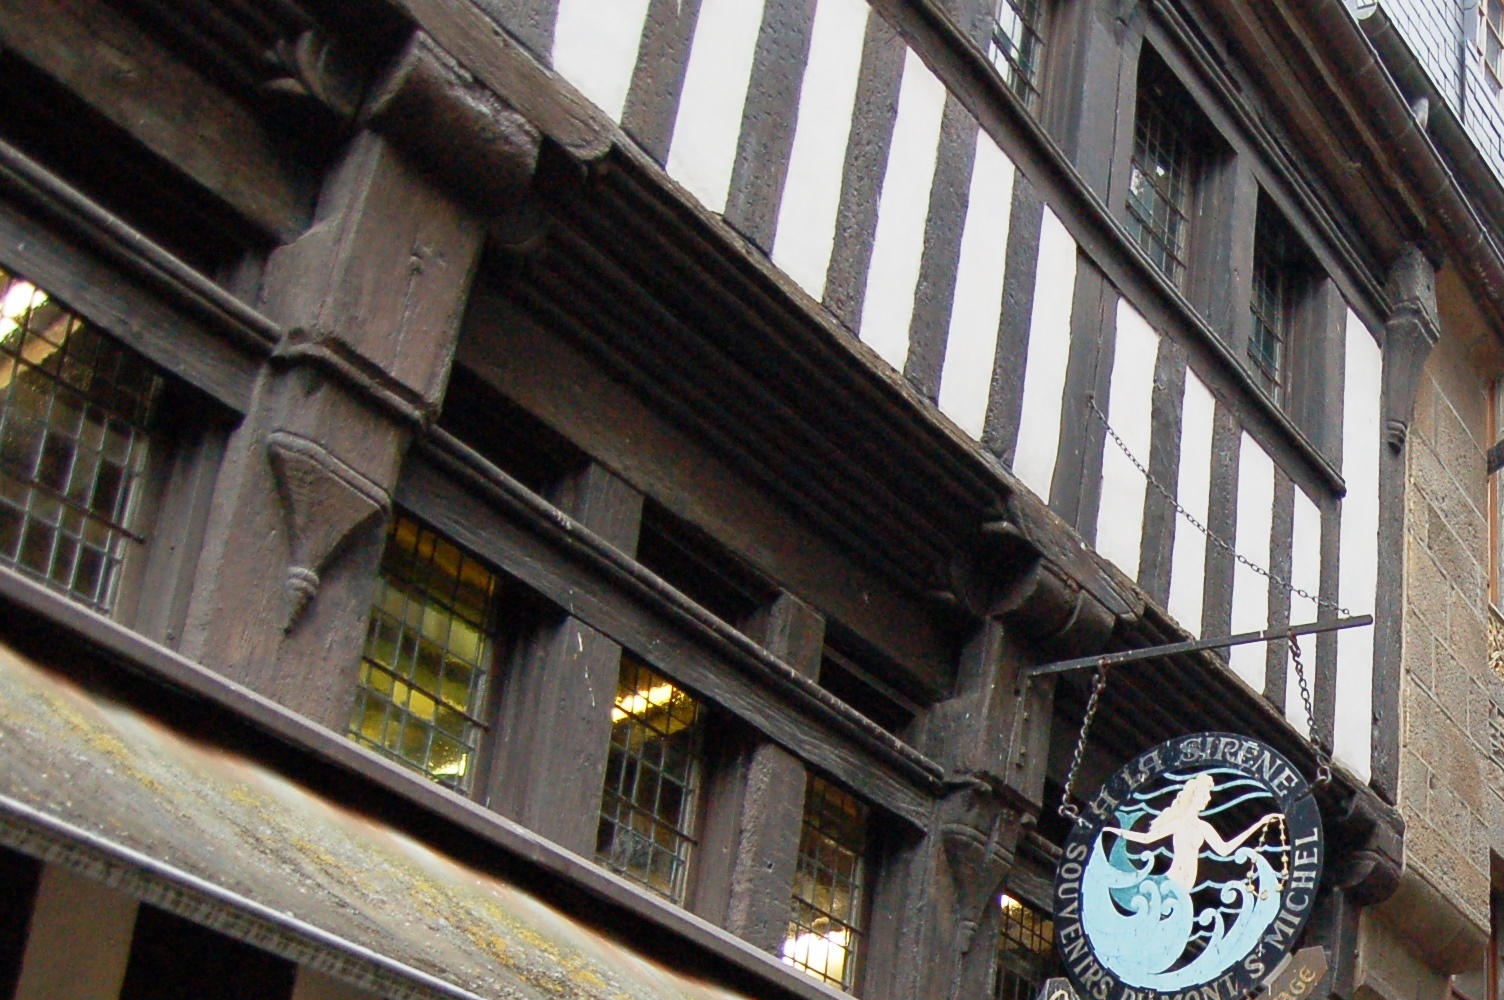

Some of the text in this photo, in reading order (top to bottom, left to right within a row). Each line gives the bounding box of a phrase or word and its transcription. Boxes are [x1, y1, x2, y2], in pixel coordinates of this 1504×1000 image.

[1120, 750, 1165, 791] LA
[1057, 842, 1115, 1000] SOUVENIRS
[1264, 827, 1319, 951] MICHEL
